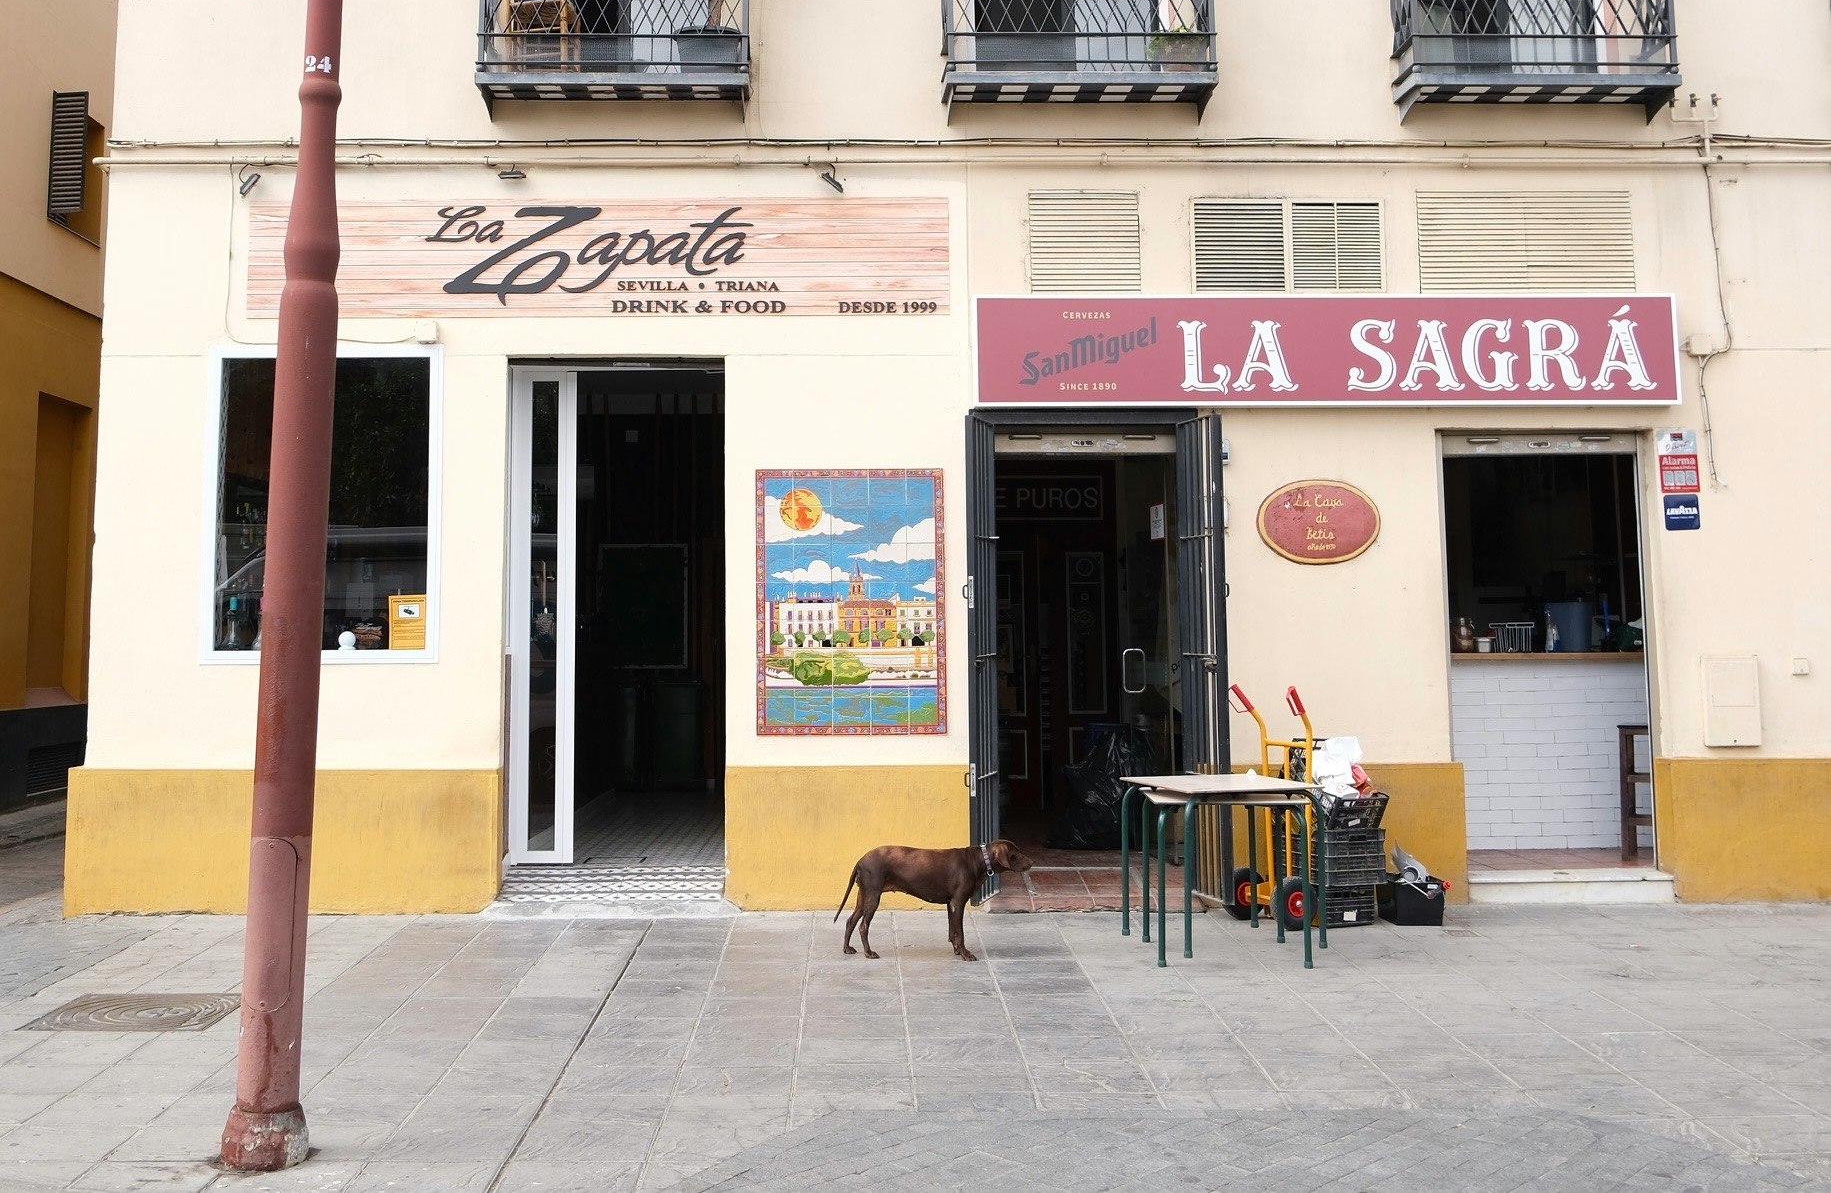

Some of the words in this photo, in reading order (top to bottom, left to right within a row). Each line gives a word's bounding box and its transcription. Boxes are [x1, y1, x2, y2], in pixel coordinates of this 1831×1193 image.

[304, 55, 332, 74] 24
[424, 206, 505, 243] La
[442, 206, 754, 306] Zapata
[617, 280, 689, 291] SEVILLA
[715, 280, 780, 291] TRIANA
[611, 300, 689, 314] DRINK
[694, 300, 713, 314] &
[720, 300, 787, 314] FOOD
[838, 301, 897, 313] DESDE
[902, 301, 938, 313] 1999
[1062, 311, 1111, 319] CERVEZAS
[1176, 320, 1299, 395] LA
[1347, 304, 1658, 392] SAGRÁ
[1059, 382, 1089, 391] SINCE
[1092, 382, 1117, 391] 1890
[1661, 456, 1696, 466] Alarma
[995, 488, 1007, 508] E
[1016, 487, 1098, 510] PUROS
[1293, 493, 1311, 507] La
[1666, 505, 1698, 515] LAVAZZA
[1315, 512, 1328, 523] de
